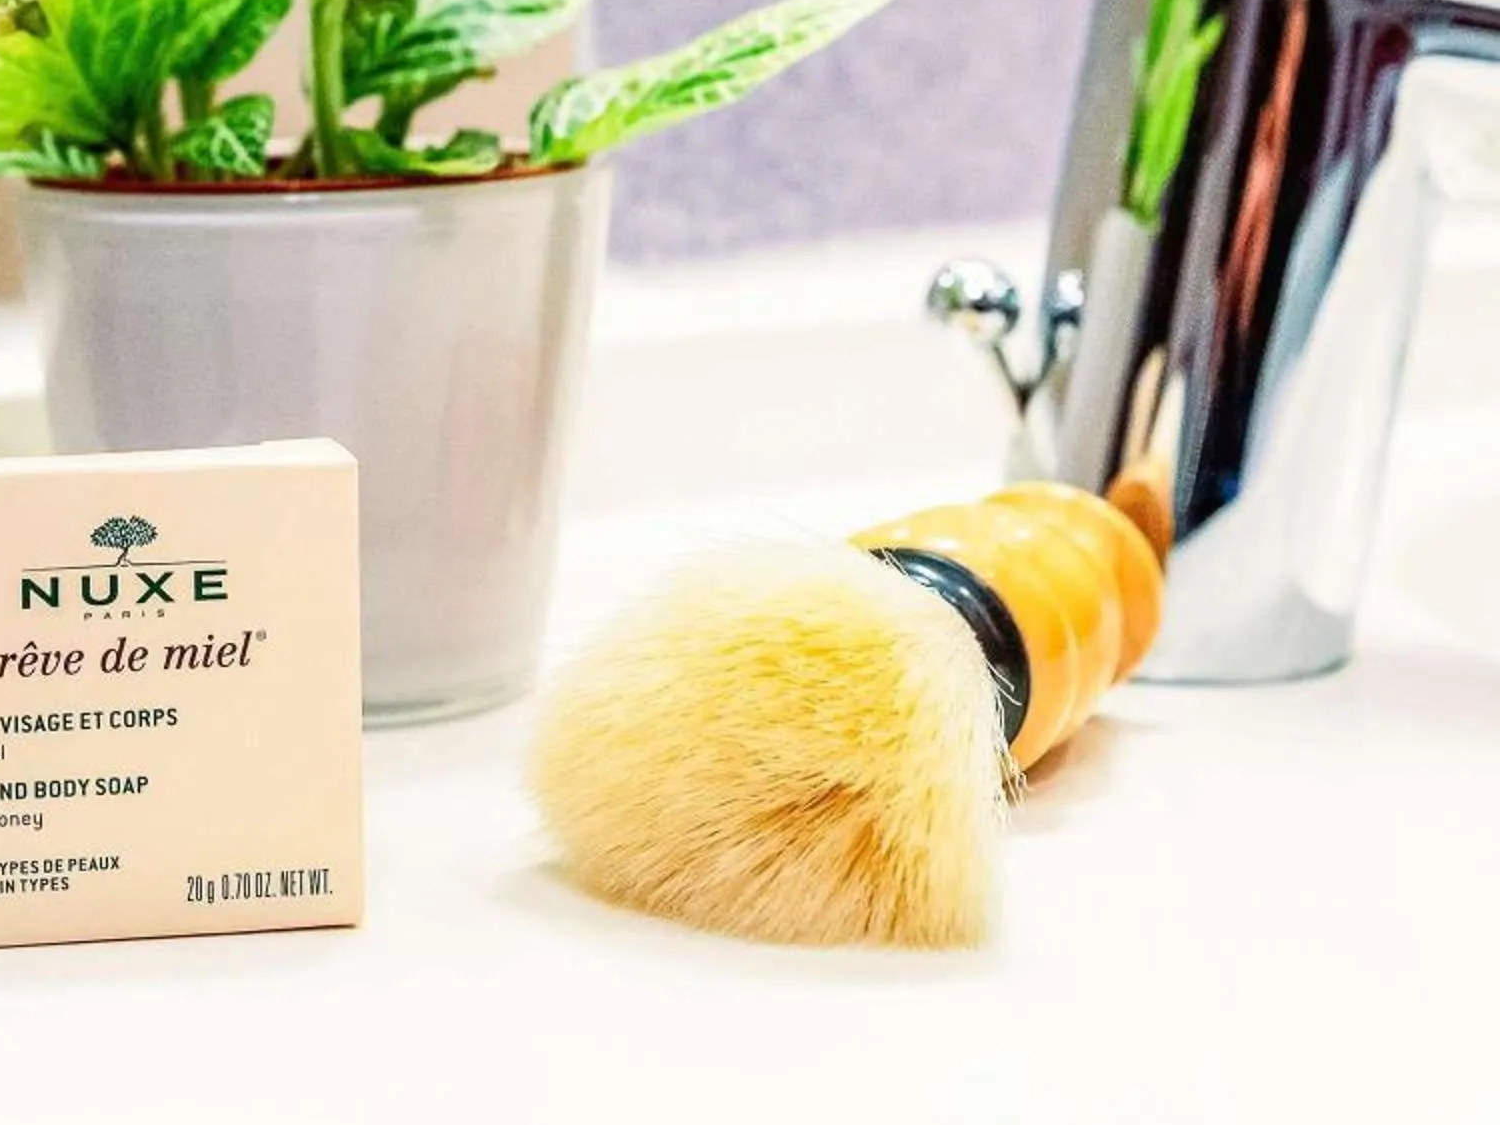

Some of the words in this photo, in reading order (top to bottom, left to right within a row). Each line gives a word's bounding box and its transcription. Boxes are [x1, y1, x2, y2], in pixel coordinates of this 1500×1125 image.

[21, 568, 228, 610] NUXE
[84, 607, 167, 621] PARIS
[100, 637, 149, 673] de
[0, 712, 74, 735] VISAGE
[80, 711, 104, 731] ET
[109, 708, 178, 729] CORPS
[35, 779, 90, 800] BODY
[95, 776, 149, 796] SOAP
[43, 858, 64, 875] DE
[68, 856, 120, 873] PEAUX
[20, 876, 69, 894] TYPES
[187, 875, 203, 902] 20
[207, 880, 215, 904] g
[221, 872, 251, 900] 0.70
[280, 869, 305, 897] NET
[308, 868, 334, 896] WT.
